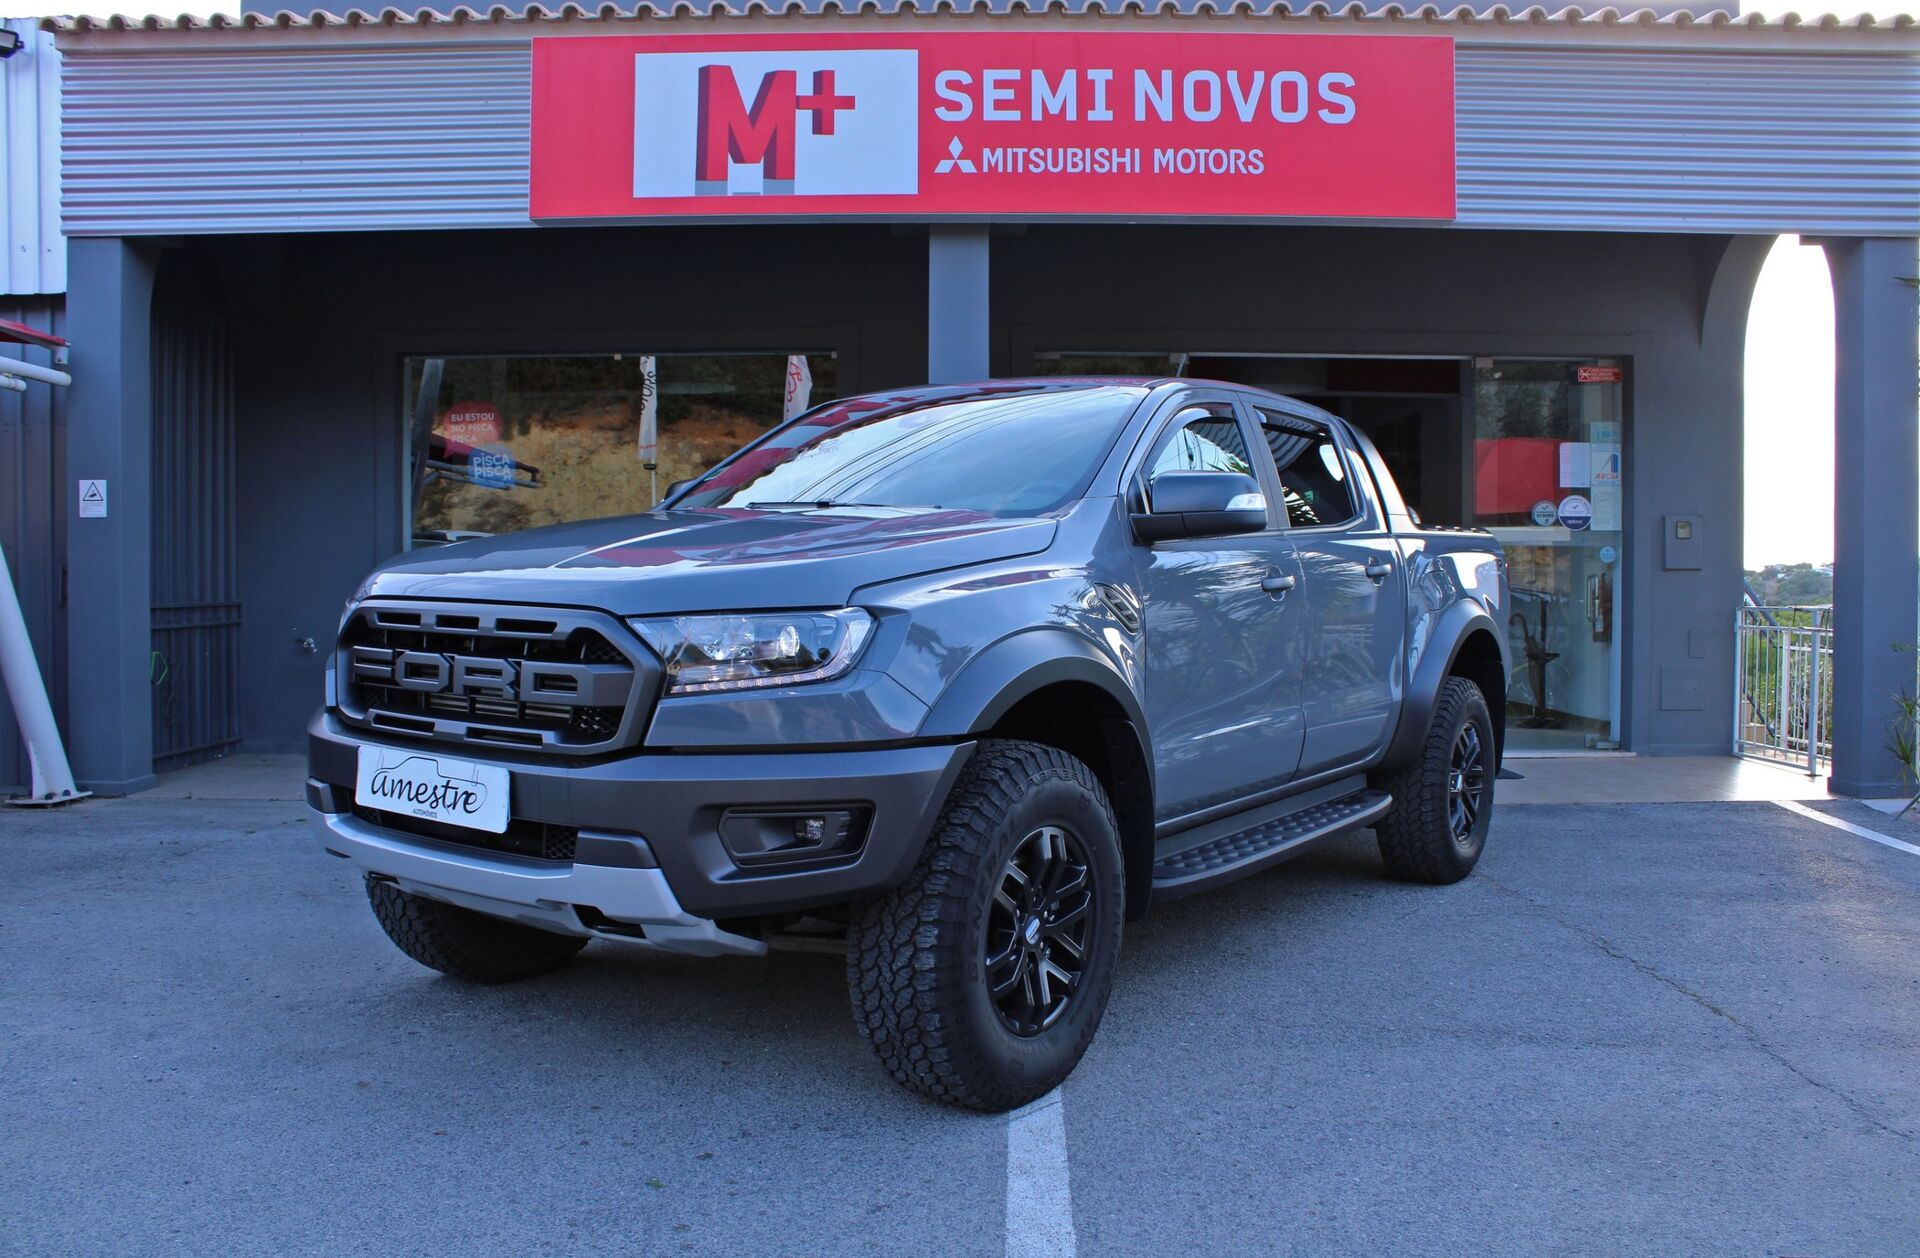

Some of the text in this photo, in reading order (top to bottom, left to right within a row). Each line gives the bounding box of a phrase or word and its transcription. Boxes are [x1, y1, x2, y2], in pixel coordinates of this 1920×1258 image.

[934, 69, 1356, 125] SEMI NOVOS
[982, 147, 1265, 175] MITSUBISHI MOTORS
[466, 413, 495, 421] ESTOU
[468, 424, 494, 432] PISCA
[351, 645, 594, 707] FORD
[371, 771, 481, 814] amestre
